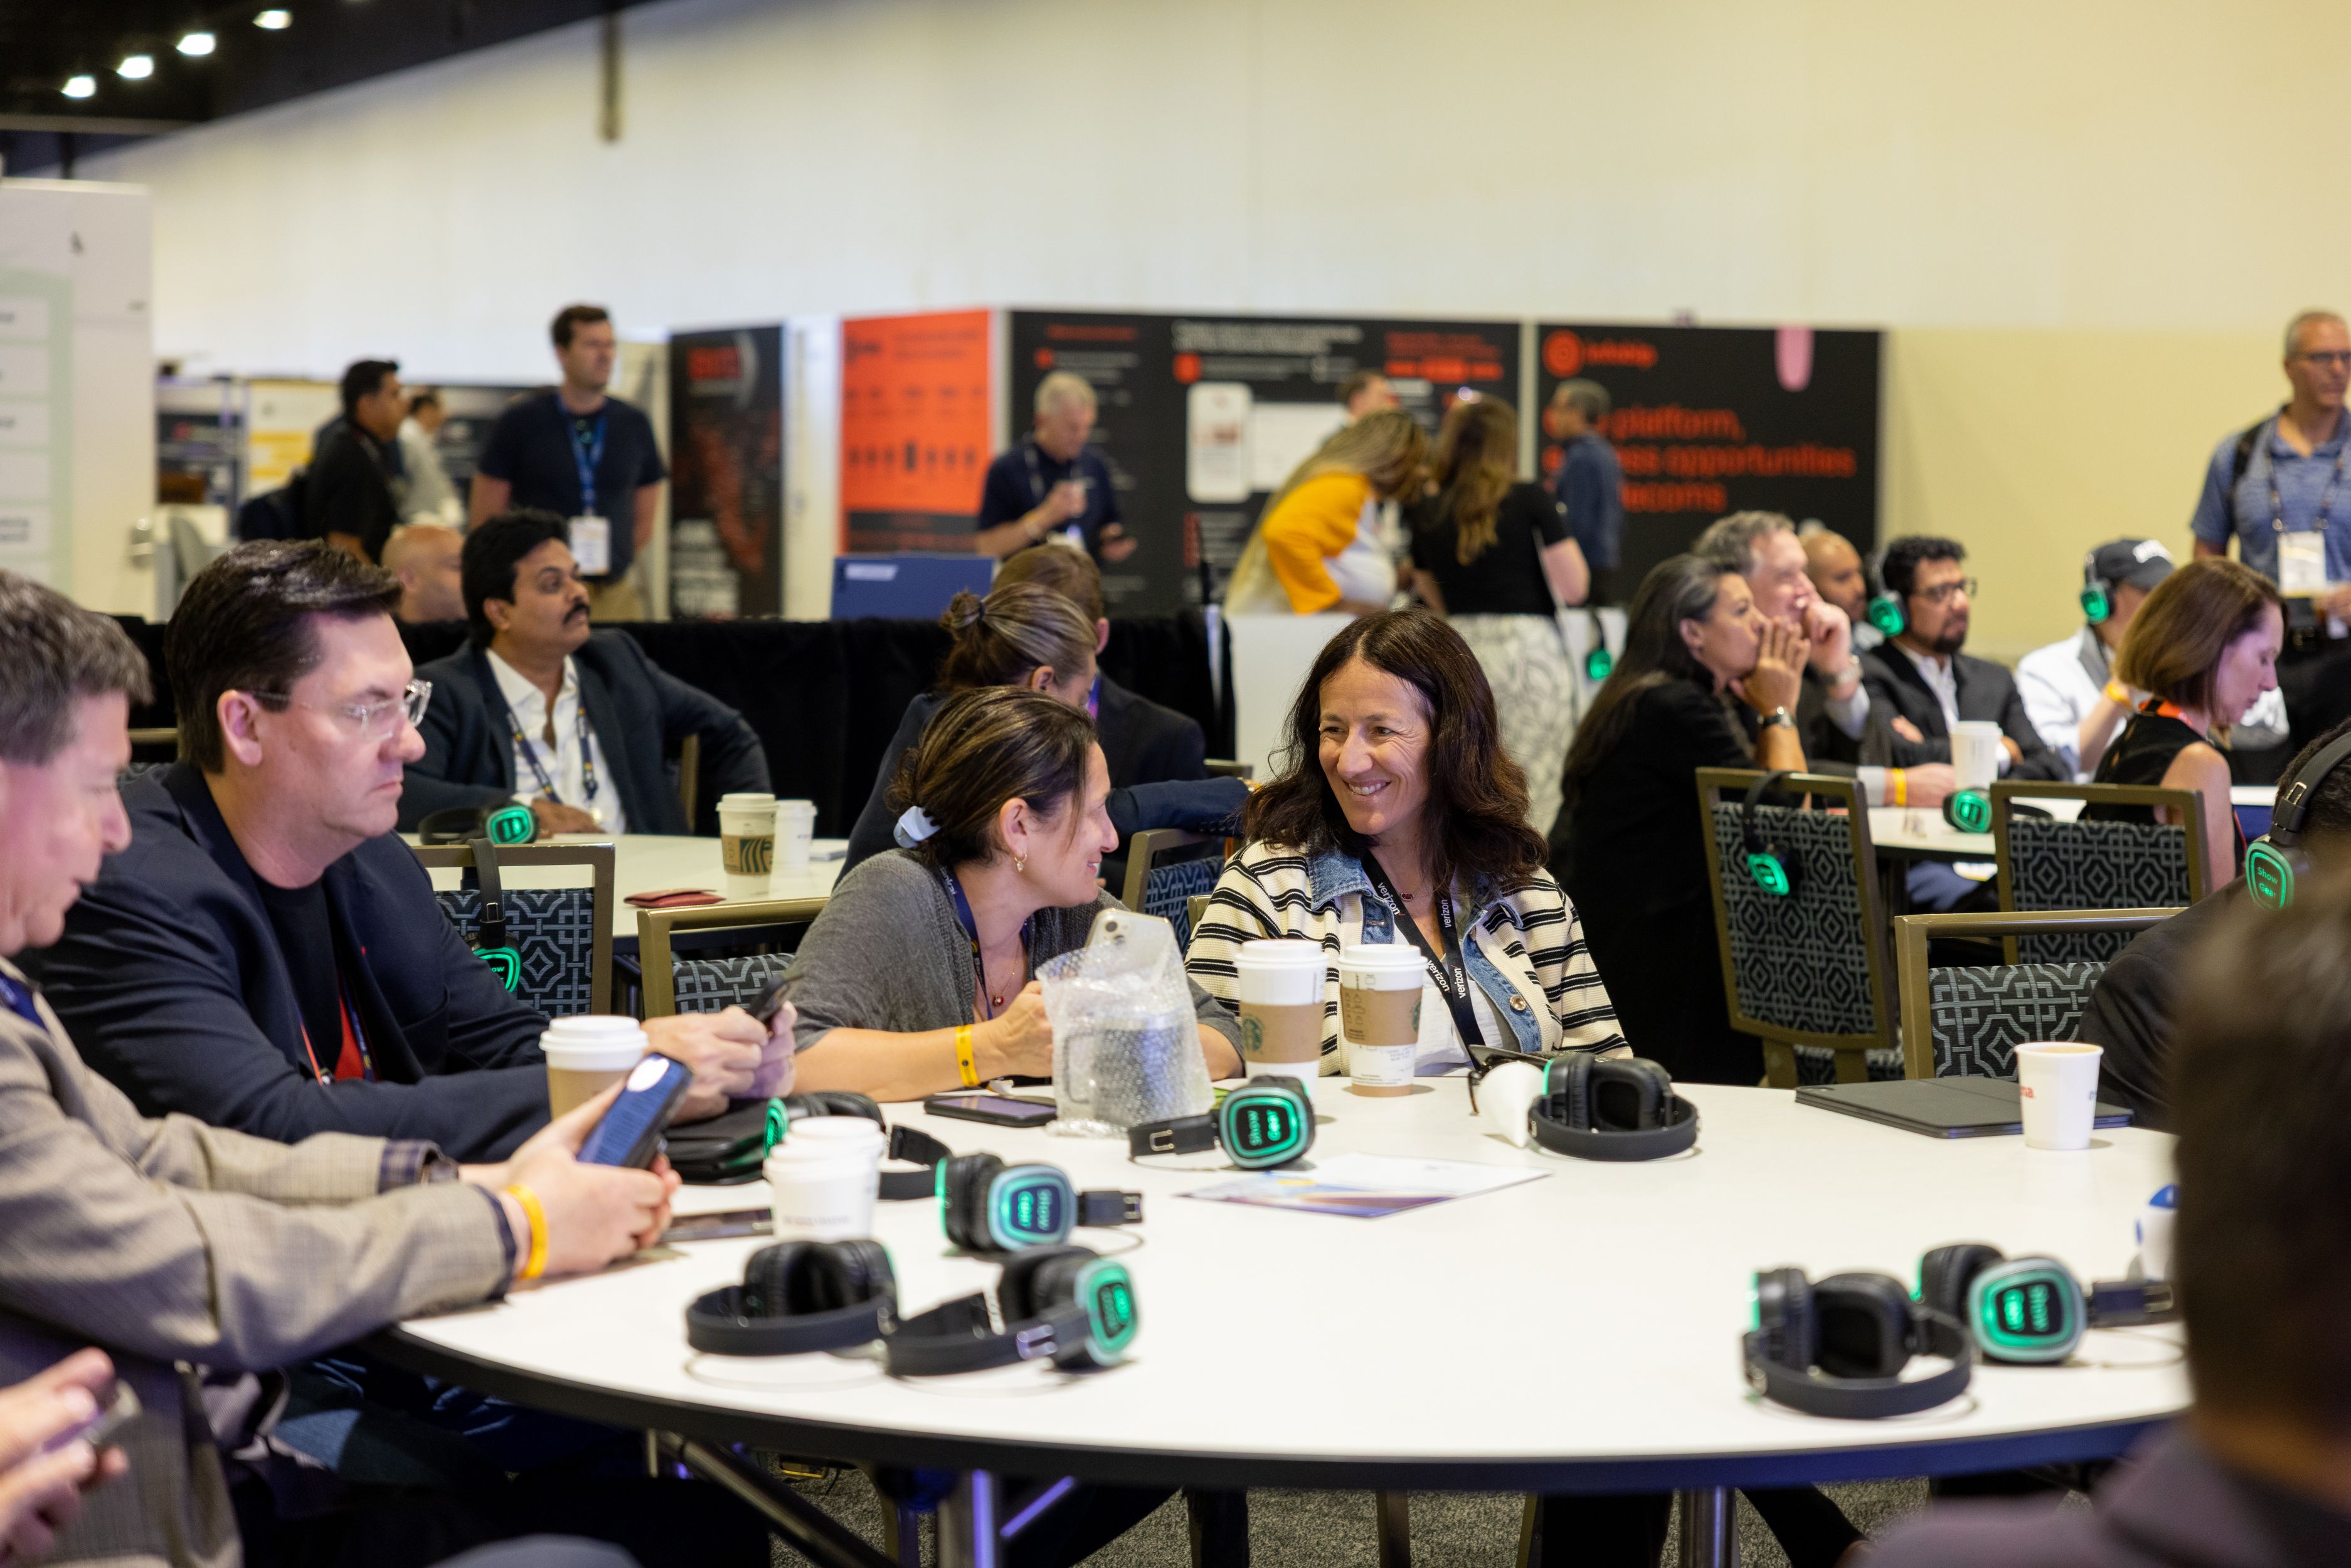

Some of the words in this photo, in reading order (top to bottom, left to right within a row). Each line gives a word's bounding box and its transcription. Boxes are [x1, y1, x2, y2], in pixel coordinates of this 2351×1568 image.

[2258, 867, 2278, 884] Show
[1377, 882, 1400, 915] verizon
[1441, 899, 1451, 928] verizon
[1427, 960, 1450, 992] verizon
[1455, 968, 1466, 999] verizon
[1247, 1110, 1262, 1147] Show
[1266, 1109, 1281, 1141] Gear
